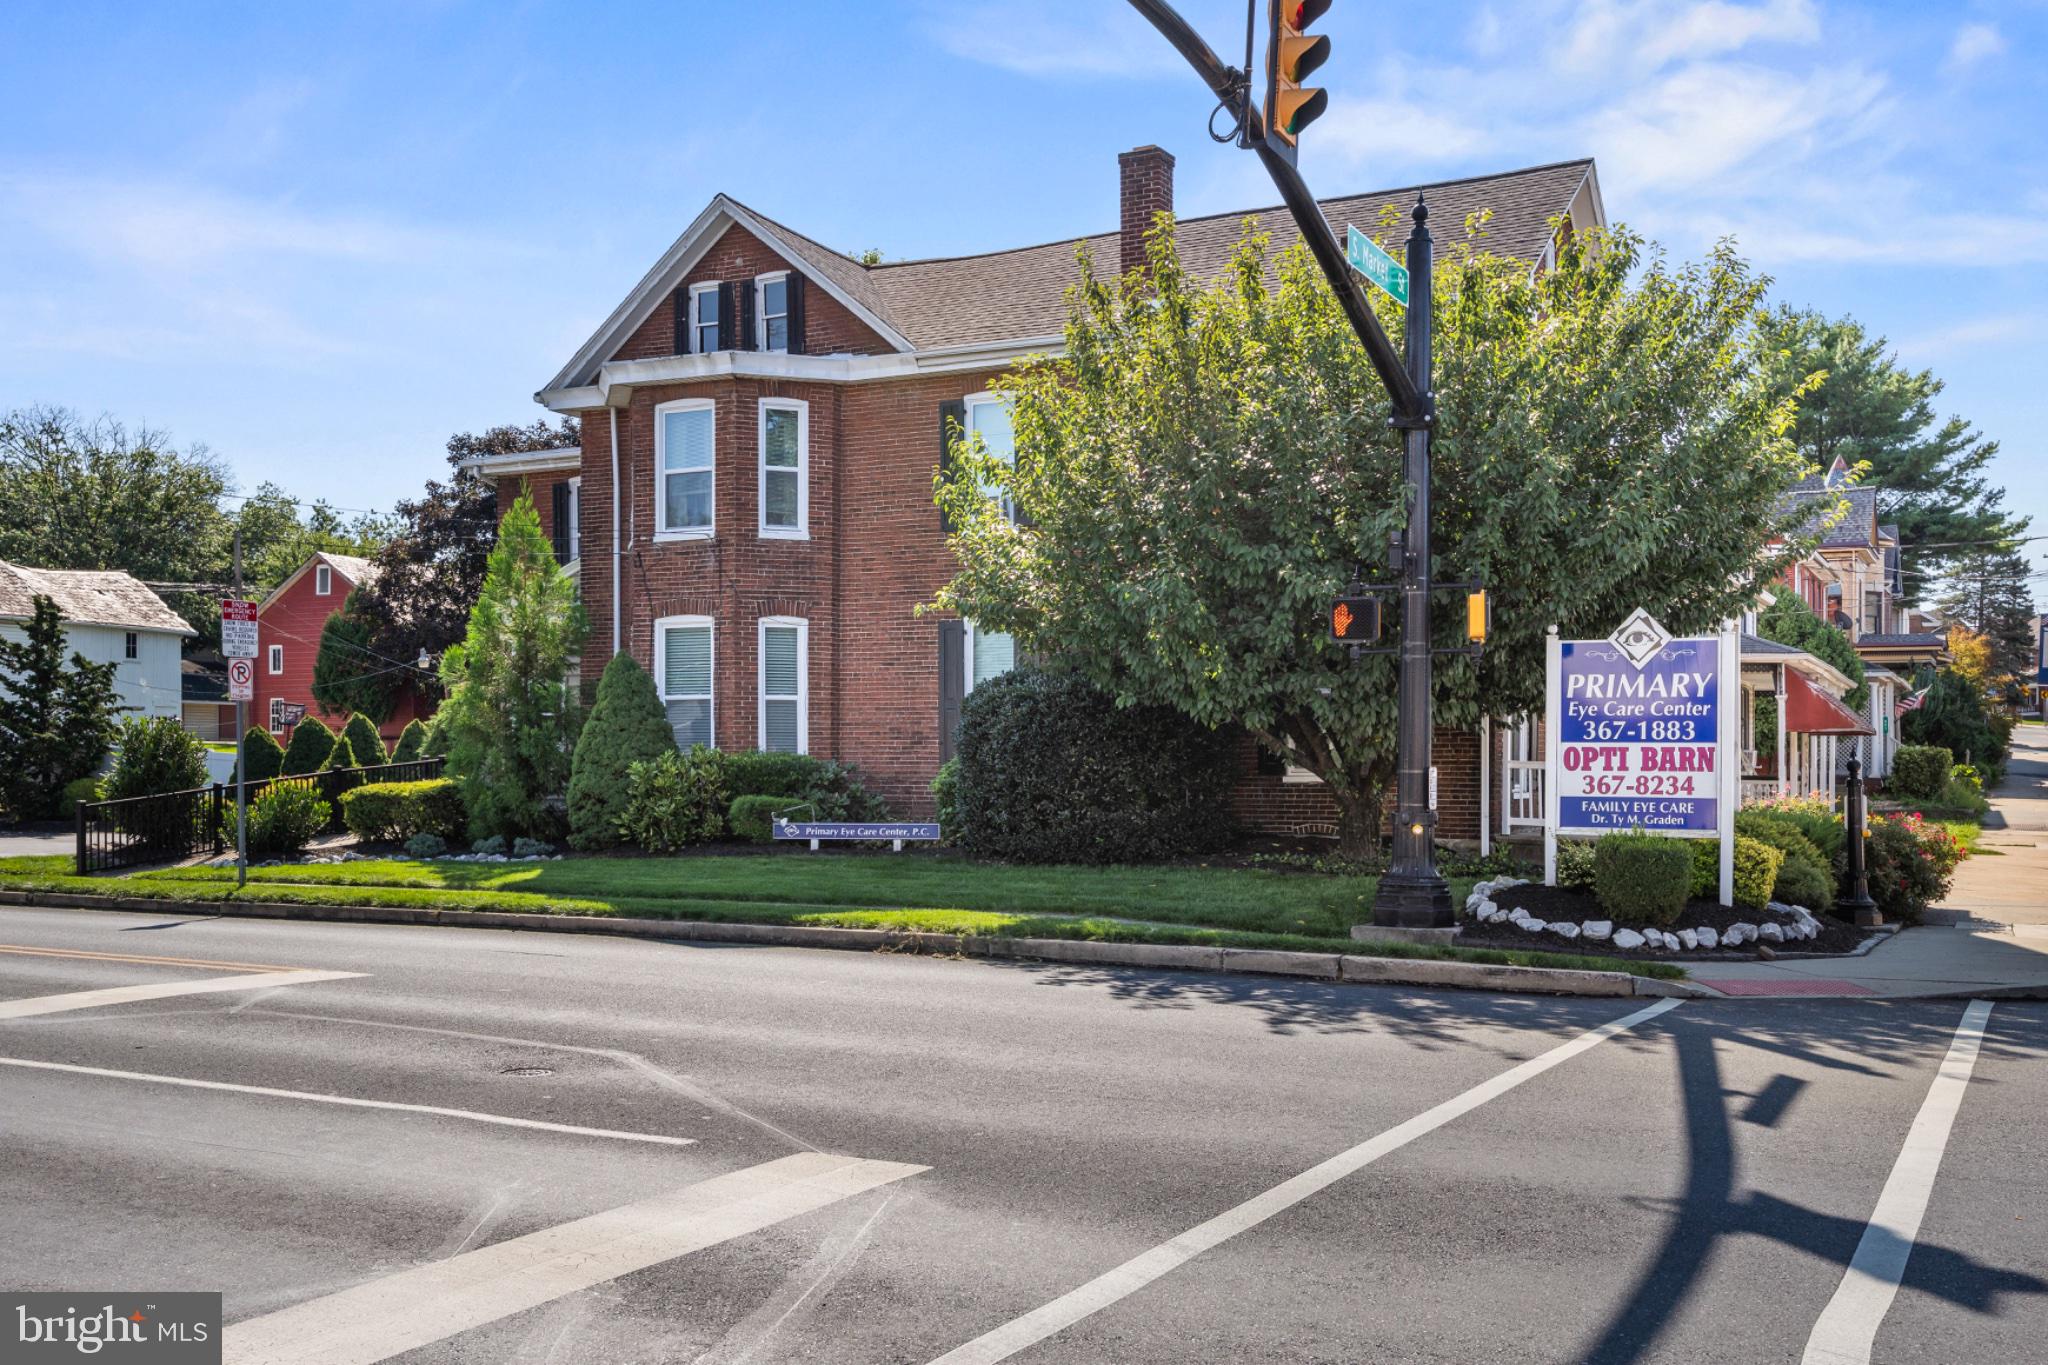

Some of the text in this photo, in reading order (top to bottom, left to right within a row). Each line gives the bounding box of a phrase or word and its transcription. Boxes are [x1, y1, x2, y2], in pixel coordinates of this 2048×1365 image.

[1363, 244, 1389, 282] Market
[231, 600, 249, 608] SNOW
[1567, 673, 1712, 698] PRIMARY
[1568, 702, 1711, 720] Eye Care Center
[1583, 721, 1696, 740] 367-1883
[1564, 747, 1715, 772] OPTI BARN
[1582, 776, 1695, 795] 367-8234
[1582, 801, 1695, 813] FAMILY EYE CARE
[1592, 815, 1684, 826] Dr. Ty M. Graden
[806, 828, 838, 837] Primary
[840, 828, 855, 837] Eye
